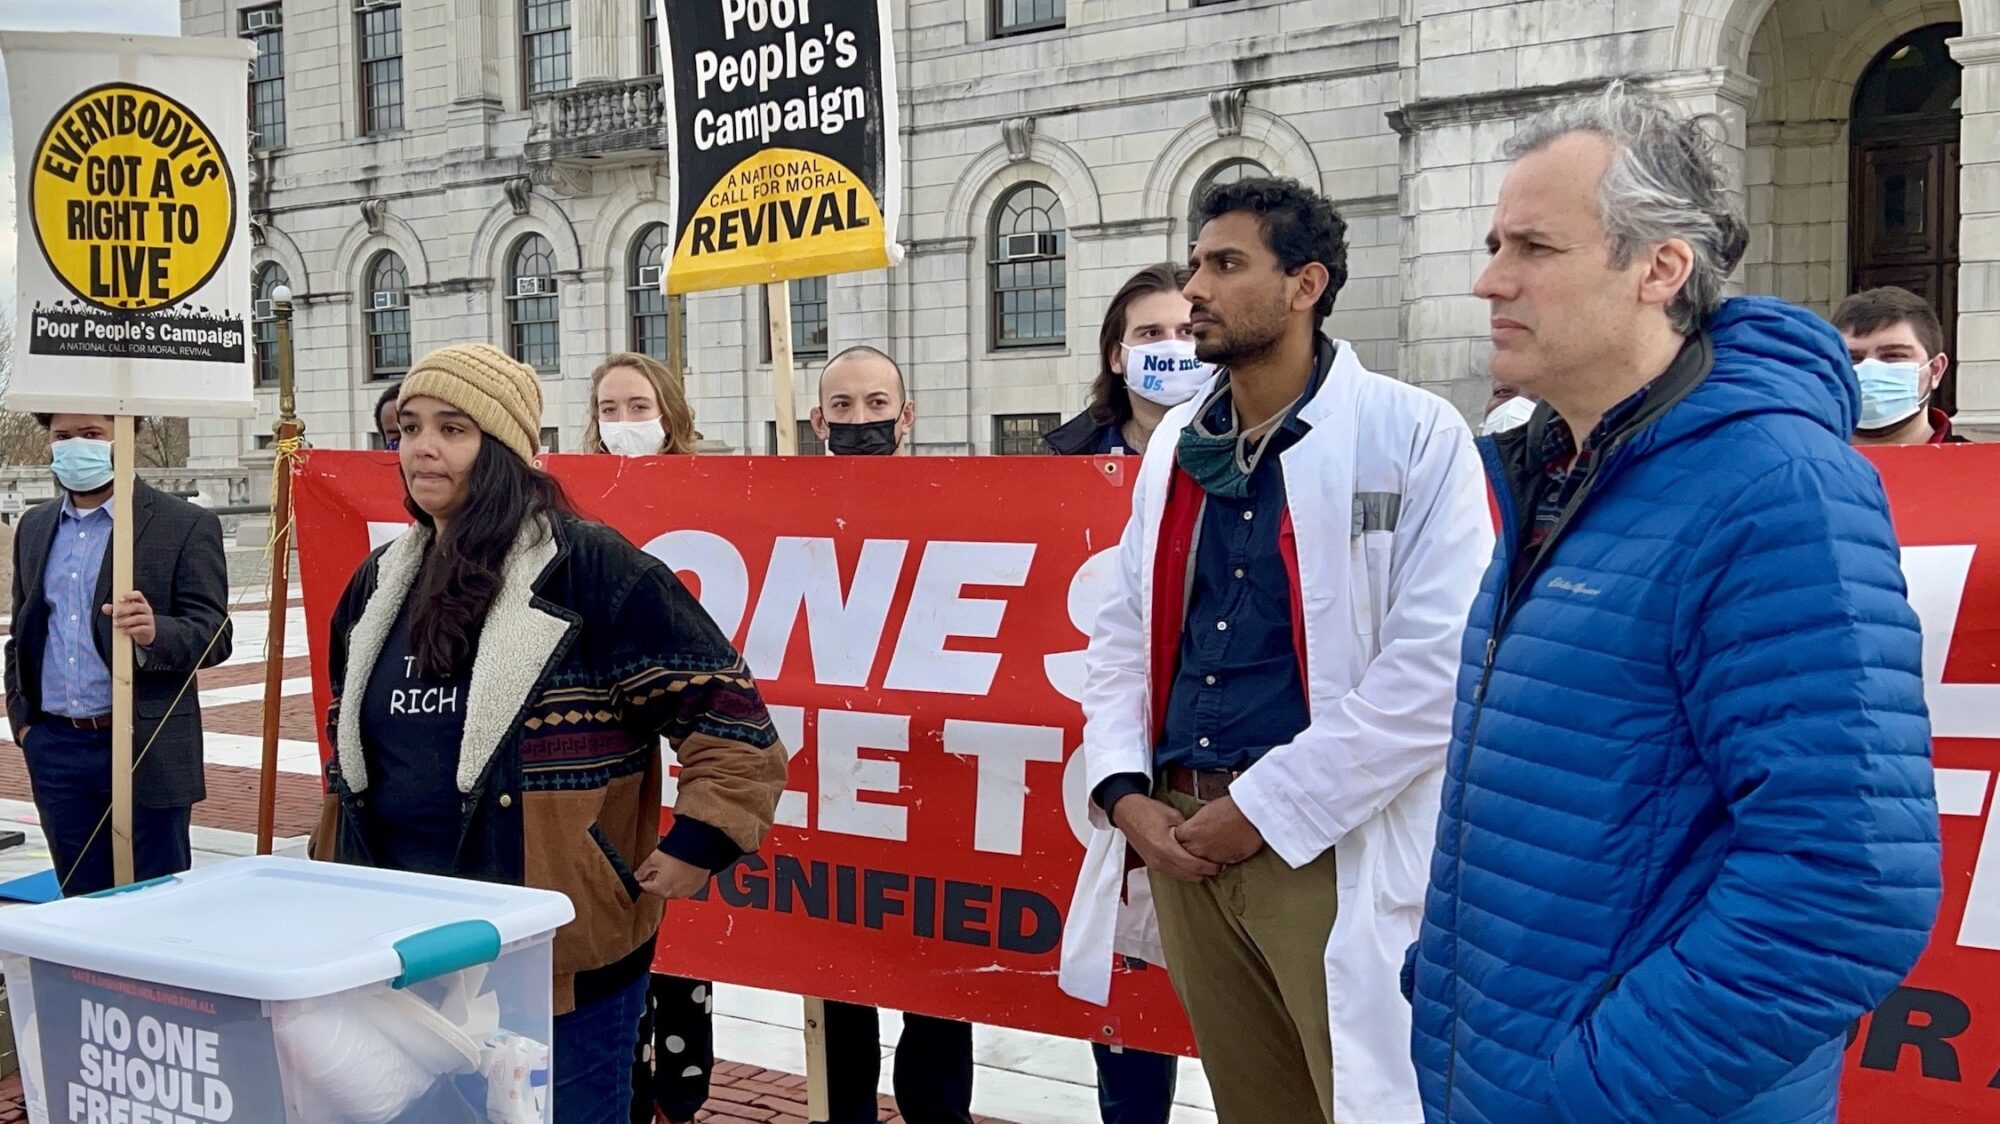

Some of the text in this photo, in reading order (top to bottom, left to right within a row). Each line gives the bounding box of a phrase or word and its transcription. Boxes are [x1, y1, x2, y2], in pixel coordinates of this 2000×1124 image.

[721, 0, 811, 40] Poor
[695, 23, 858, 99] People's
[694, 84, 865, 151] Campaign
[42, 95, 220, 187] EVERYBODY'S
[87, 155, 175, 199] GOT A
[710, 170, 846, 208] CALL FOR MORAL
[727, 159, 822, 189] A NATIONAL
[67, 200, 199, 244] RIGHT TO
[691, 188, 870, 257] REVIVAL
[90, 244, 171, 299] LIVE
[36, 317, 242, 348] Poor People's Campaign
[67, 343, 106, 352] NATIONAL
[108, 344, 127, 353] CALL
[129, 345, 146, 353] FOR
[148, 345, 177, 355] MORAL
[179, 347, 212, 357] REVIVAL
[1143, 355, 1175, 372] Not
[1143, 375, 1164, 391] Us.
[390, 686, 457, 715] RICH
[943, 718, 1090, 856] T
[689, 850, 1062, 954] GNIFIED
[81, 998, 219, 1076] NO ONE
[80, 1043, 233, 1122] SHOULD
